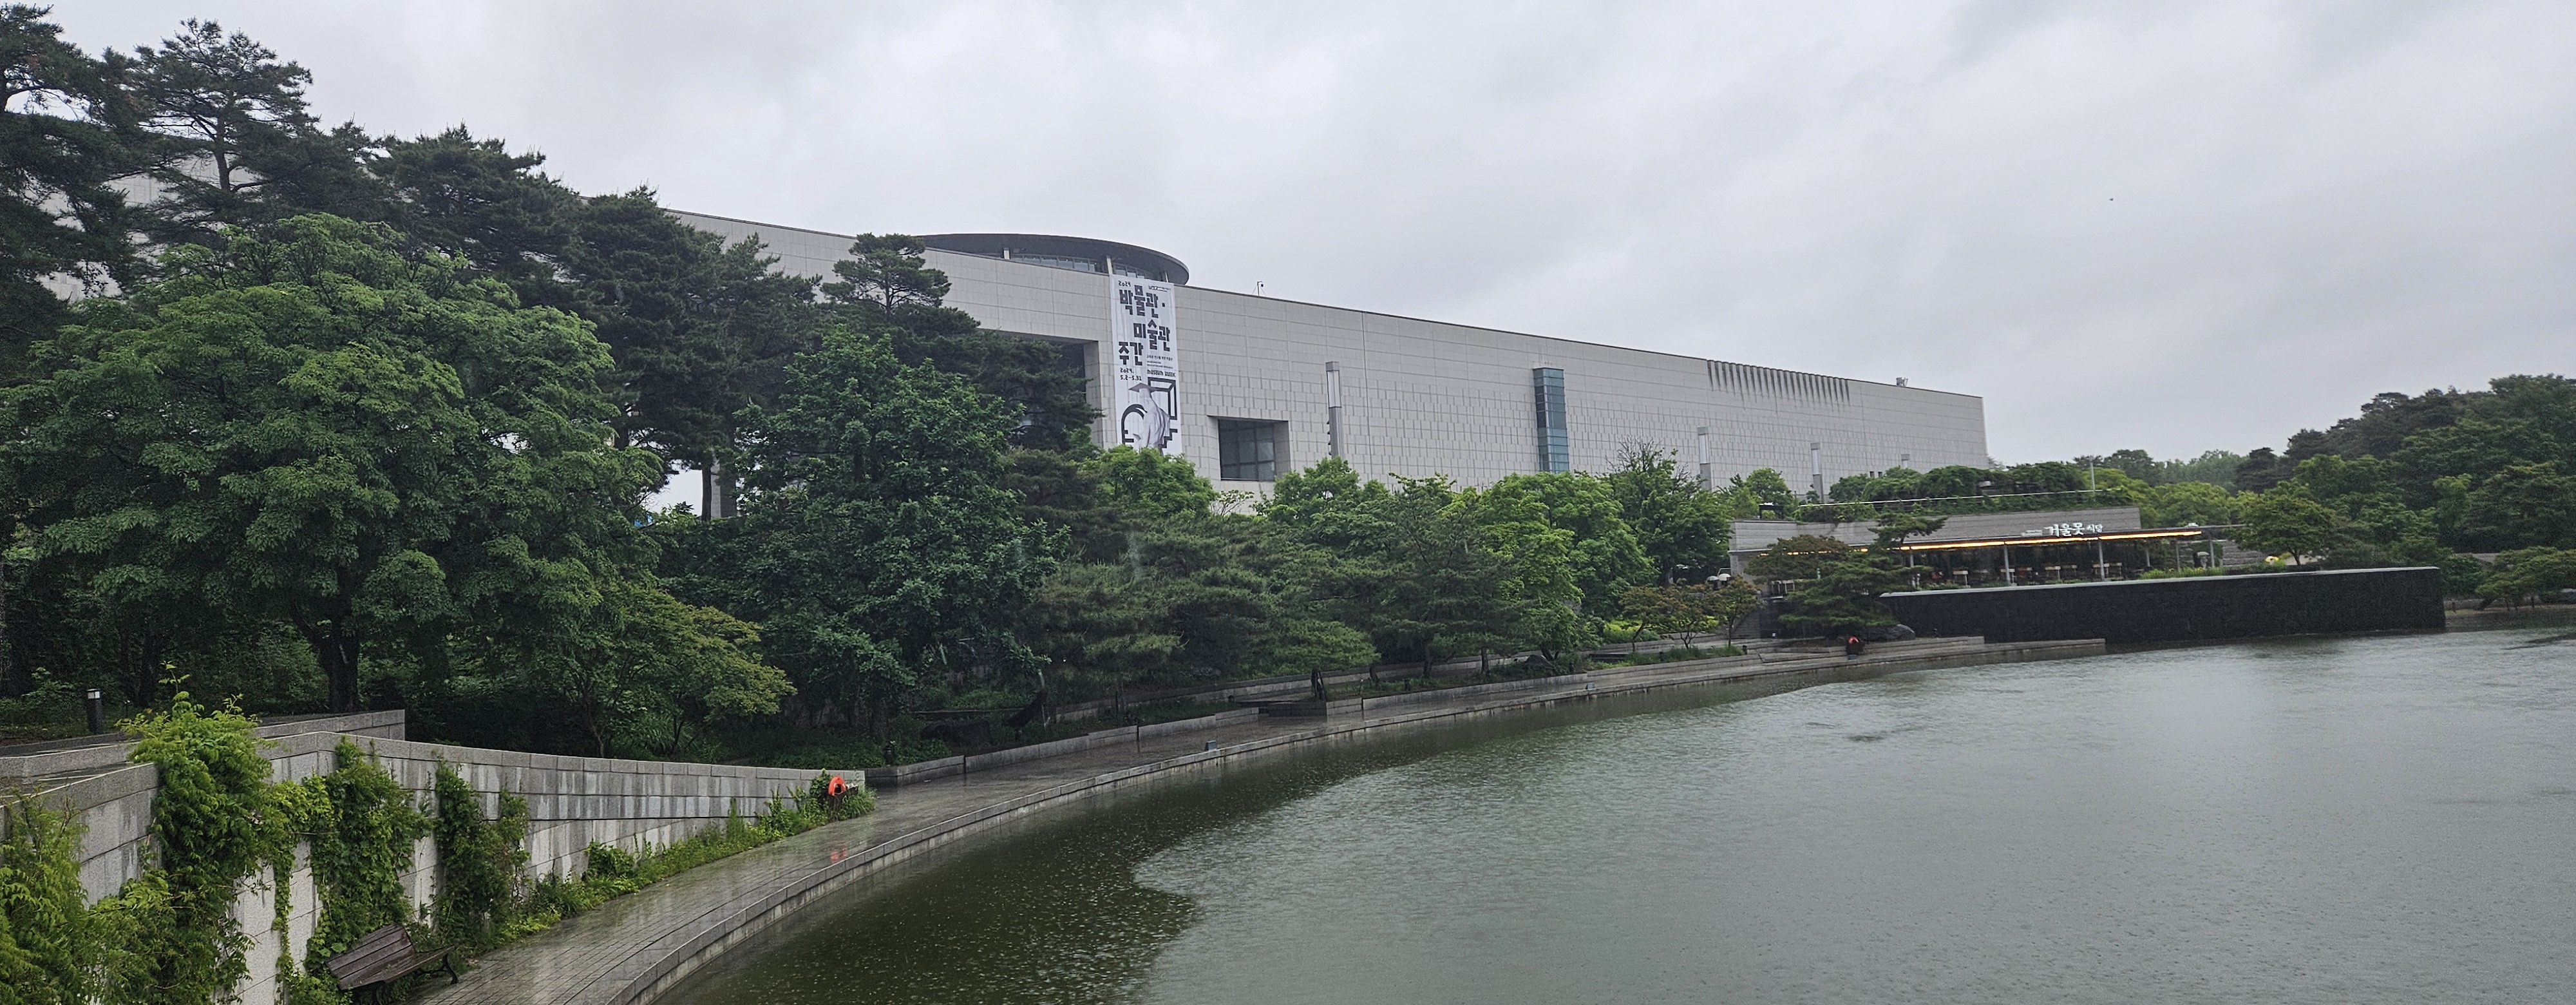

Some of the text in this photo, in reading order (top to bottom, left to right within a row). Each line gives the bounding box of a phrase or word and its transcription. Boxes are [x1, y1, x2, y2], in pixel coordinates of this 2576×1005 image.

[1133, 319, 1171, 352] 미술관
[1119, 341, 1144, 366] 주간
[2043, 522, 2085, 537] 거울못
[2086, 524, 2103, 533] 식당
